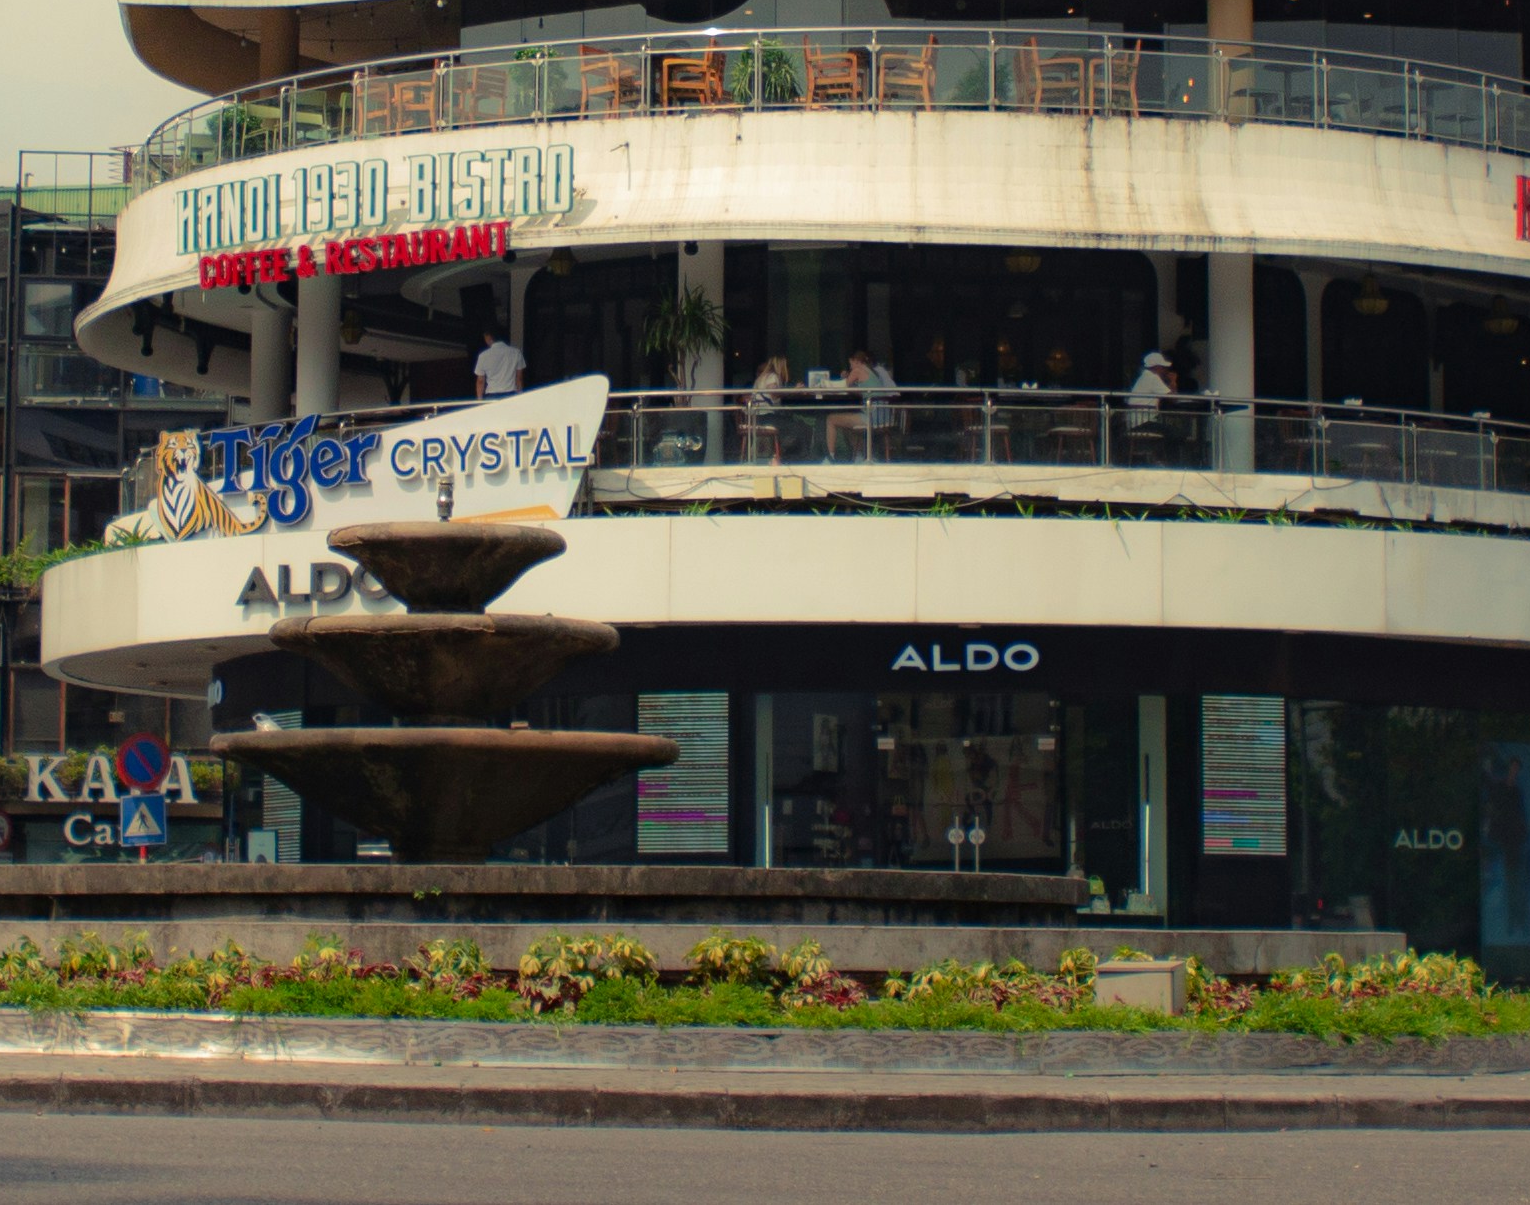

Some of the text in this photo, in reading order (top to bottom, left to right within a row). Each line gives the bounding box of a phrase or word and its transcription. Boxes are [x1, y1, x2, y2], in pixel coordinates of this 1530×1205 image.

[175, 142, 575, 256] HANOI 1930 BISTRO
[199, 221, 511, 290] COFFEE & RESTAURANT
[207, 414, 589, 525] Tiger CRYSTAL
[891, 642, 1040, 672] ALDO
[24, 753, 199, 804] KAA
[1394, 827, 1464, 851] ALDO
